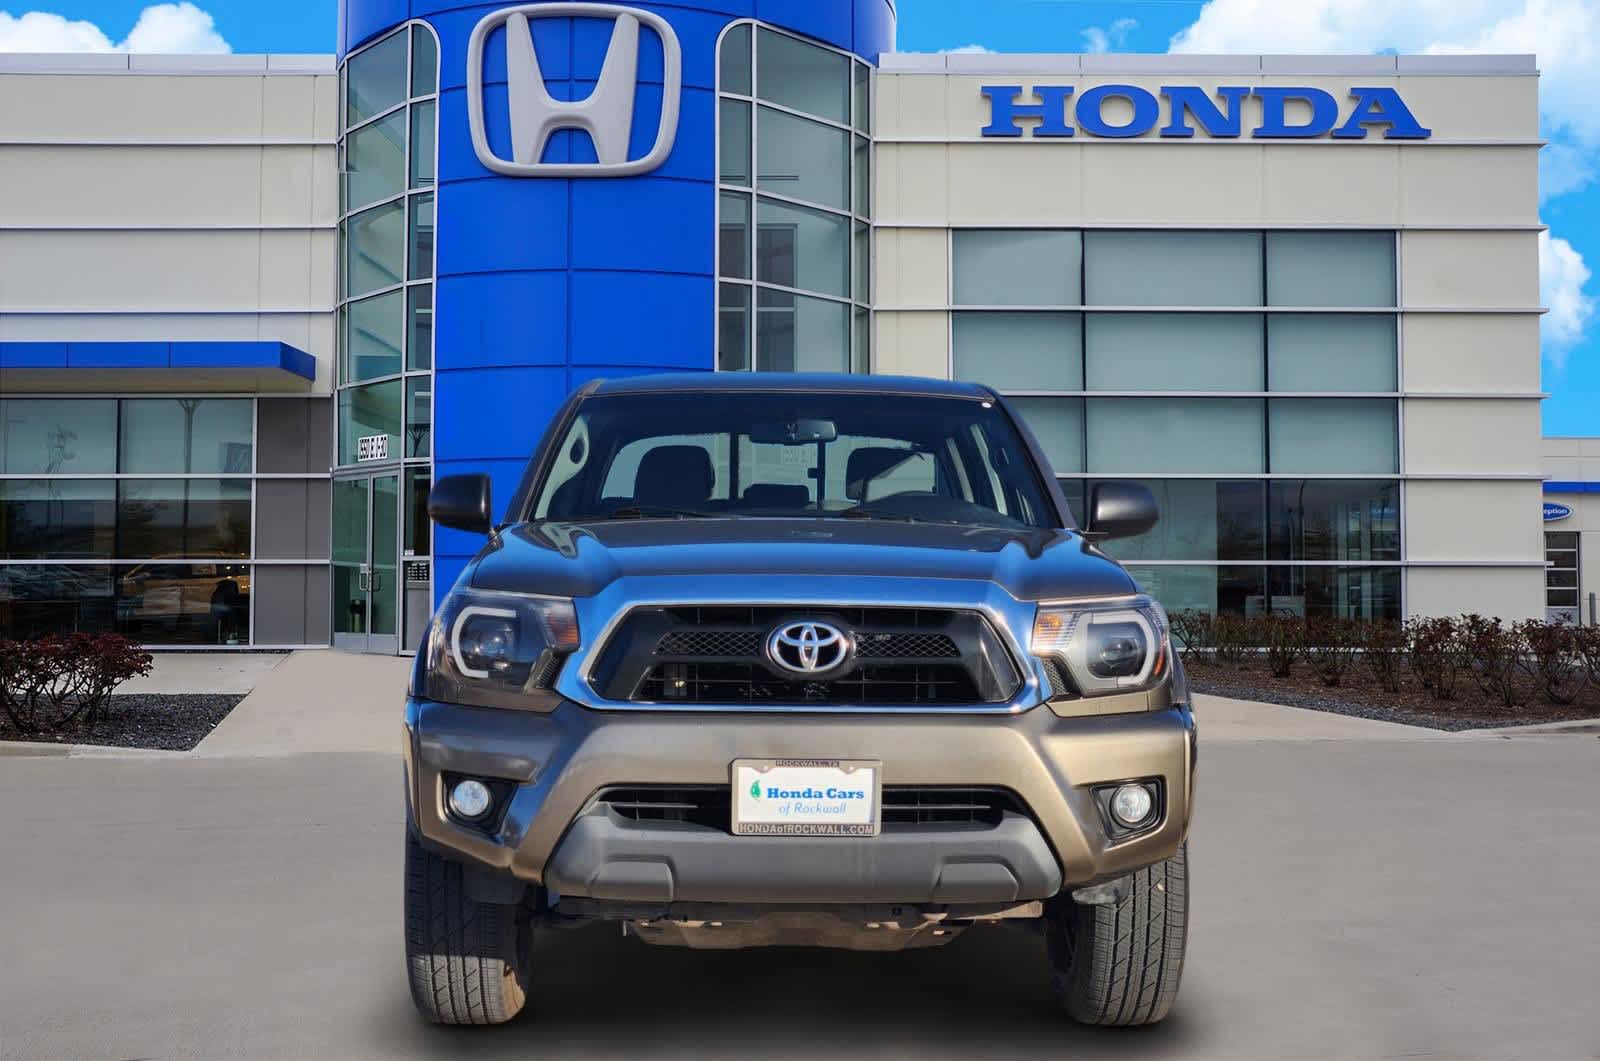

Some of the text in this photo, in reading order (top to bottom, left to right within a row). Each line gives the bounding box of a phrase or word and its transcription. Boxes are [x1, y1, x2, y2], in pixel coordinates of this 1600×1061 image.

[980, 84, 1432, 140] HONDA
[767, 787, 865, 799] Honda Cars
[778, 802, 848, 816] of Rockwall
[739, 824, 873, 834] HONDAofROCKWALL.COM
